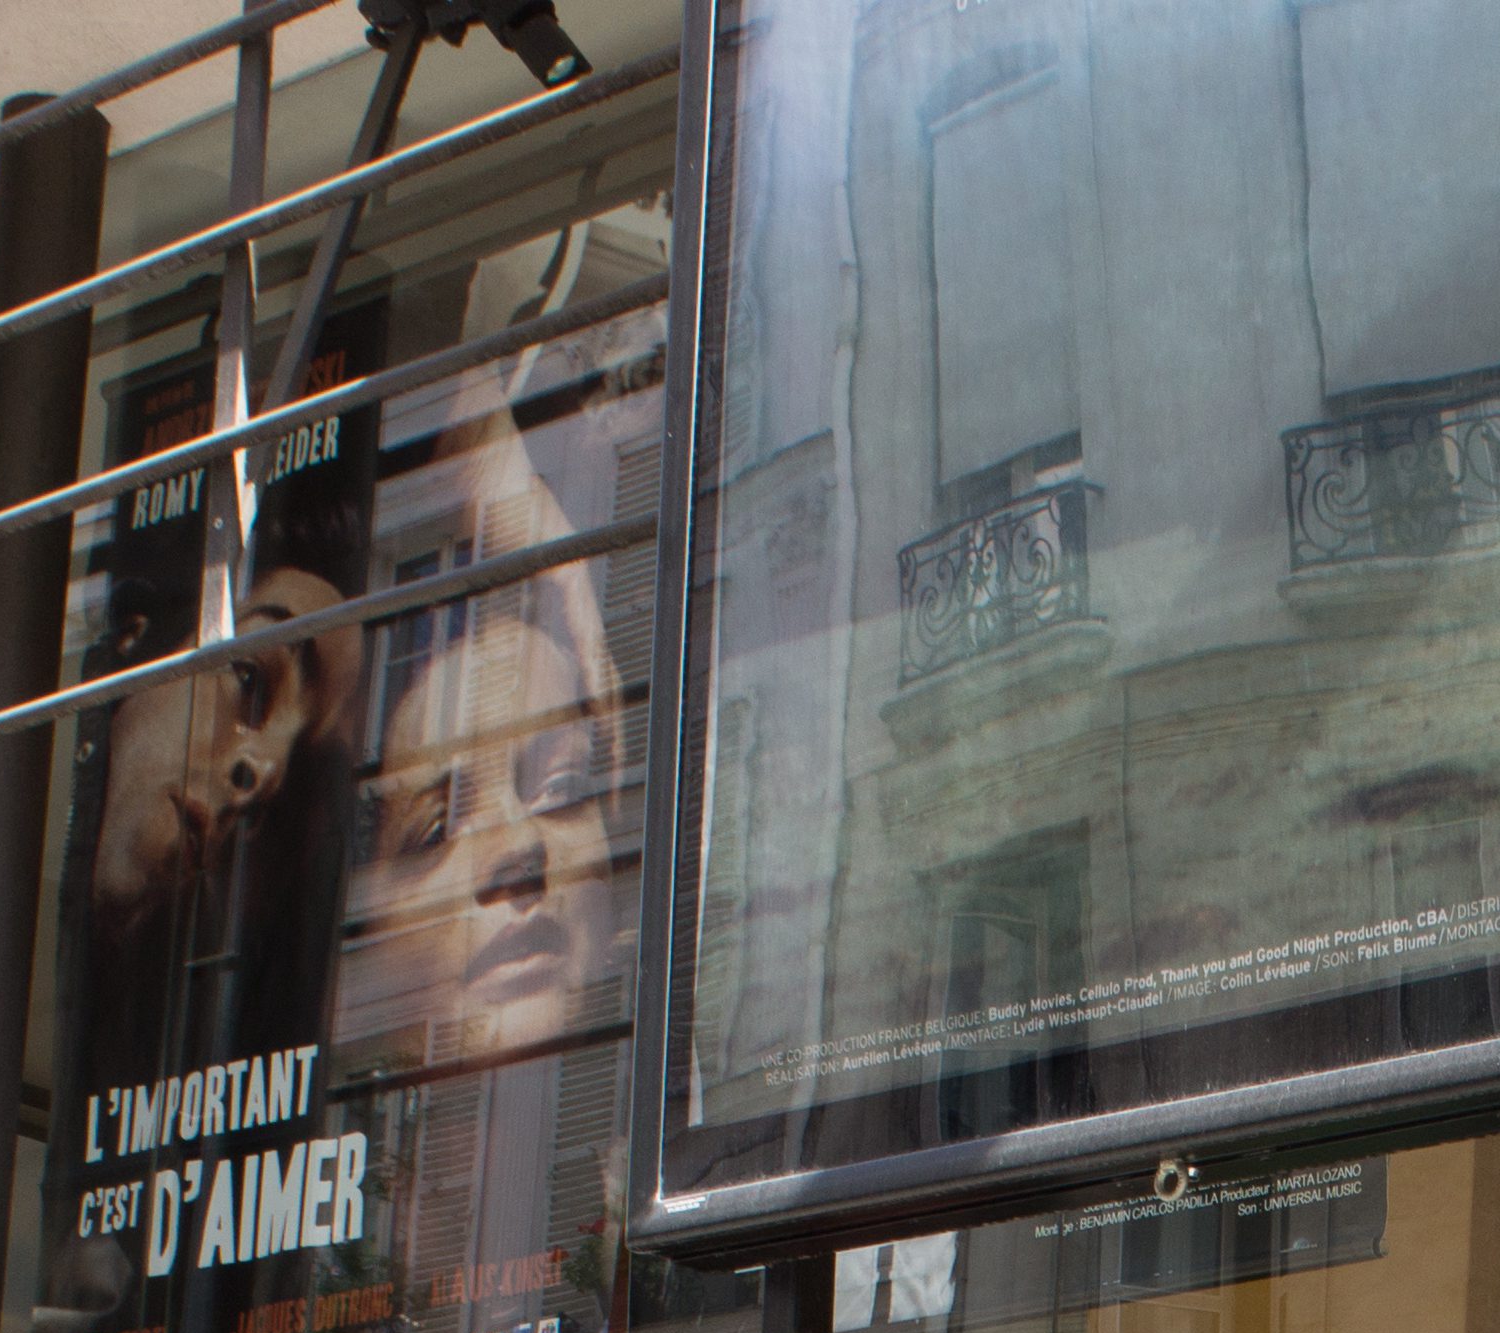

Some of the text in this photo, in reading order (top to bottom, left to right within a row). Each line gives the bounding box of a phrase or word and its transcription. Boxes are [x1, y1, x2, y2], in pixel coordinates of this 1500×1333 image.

[132, 470, 205, 532] ROMY
[760, 1051, 784, 1068] UNE
[787, 1033, 876, 1064] CO-PRODUCTION
[878, 1022, 923, 1047] FRANCE
[924, 1010, 987, 1038] BELGIQUE:
[988, 1001, 1028, 1024] Buddy
[1030, 990, 1076, 1015] Movies,
[1079, 976, 1118, 1003] Cellulo
[1122, 970, 1158, 994] Prod,
[1161, 963, 1199, 983] Thank
[1202, 960, 1226, 979] you
[1229, 951, 1253, 971] and
[1256, 941, 1290, 963] Good
[1293, 932, 1330, 957] Night
[1334, 917, 1413, 947] Production,
[765, 1057, 842, 1087] RÉALISATION:
[842, 1047, 891, 1073] Aurélien
[893, 1039, 942, 1064] Lévêque
[1013, 1015, 1045, 1039] Lydie
[1049, 989, 1163, 1031] Wisshaupt-Claudel
[1220, 969, 1252, 991] Colin
[1256, 958, 1311, 982] Lévêque
[1357, 941, 1390, 962] Felix
[85, 1044, 318, 1164] L'IMPORTANT
[78, 1131, 367, 1277] C'EST D'AIMER
[1079, 1164, 1361, 1231] BENJAMIN CARLOS PADILLA Producteur MARTA LOZANO
[1238, 1181, 1362, 1217] Son UNIVERSAL MUSIC
